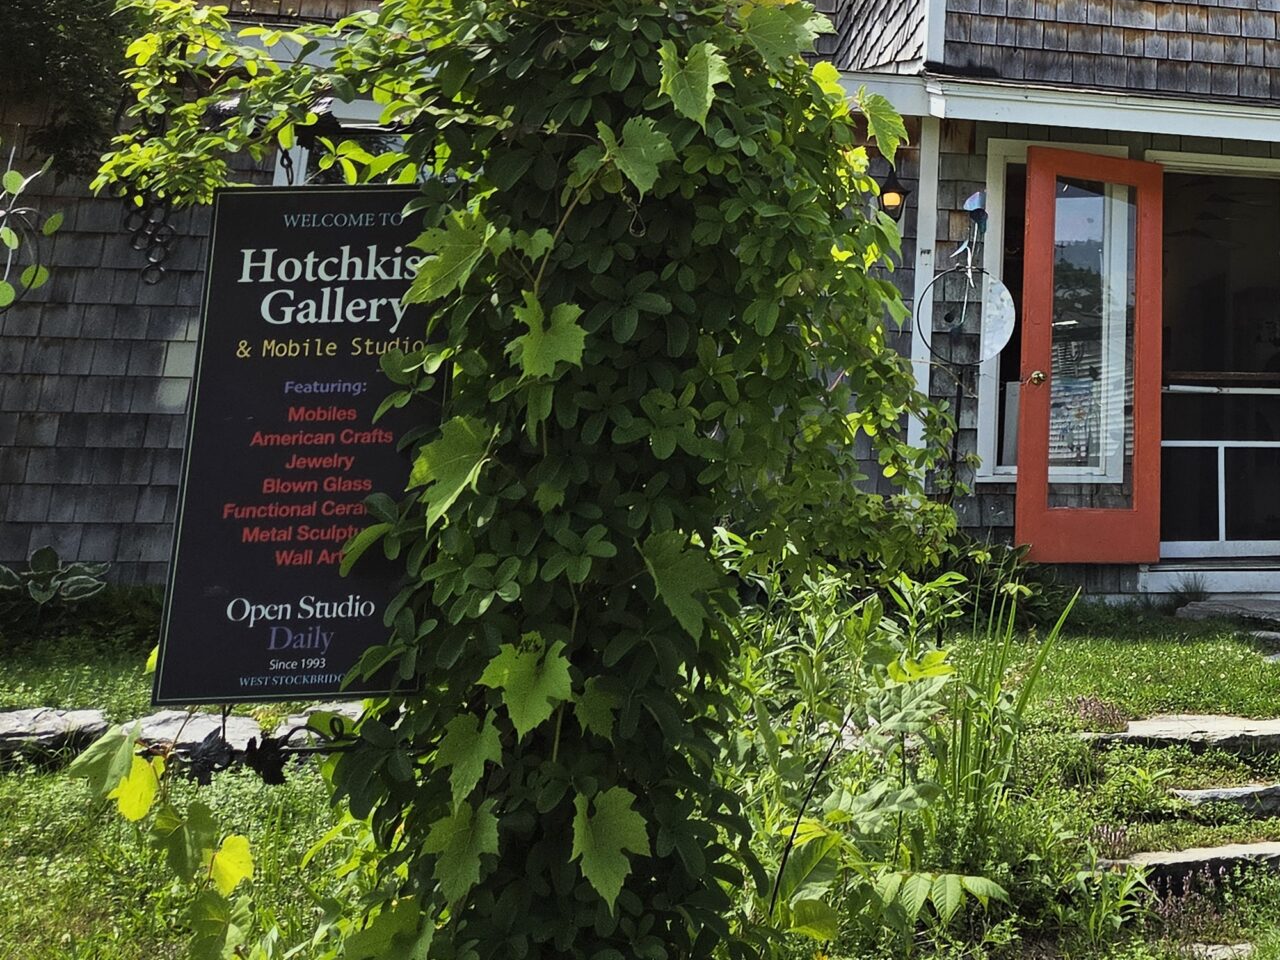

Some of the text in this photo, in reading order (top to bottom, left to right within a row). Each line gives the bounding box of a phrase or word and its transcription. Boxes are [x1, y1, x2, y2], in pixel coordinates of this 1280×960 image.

[283, 212, 404, 228] WELCOME TO
[237, 244, 422, 283] Hotchkis
[260, 286, 408, 334] Gallery
[236, 337, 425, 358] & Mobile Studio
[284, 379, 367, 396] Featuring:
[288, 406, 357, 422] Mobiles
[250, 428, 393, 447] American Crafts
[285, 453, 354, 471] Jewelry
[262, 476, 373, 494] Blown Glass
[223, 500, 368, 519] Functional Cera
[242, 526, 292, 543] Metal
[275, 549, 312, 566] Wall
[226, 594, 376, 628] Open Studio
[267, 625, 335, 656] Daily
[269, 657, 327, 671] Since 1993
[239, 676, 270, 687] WEST
